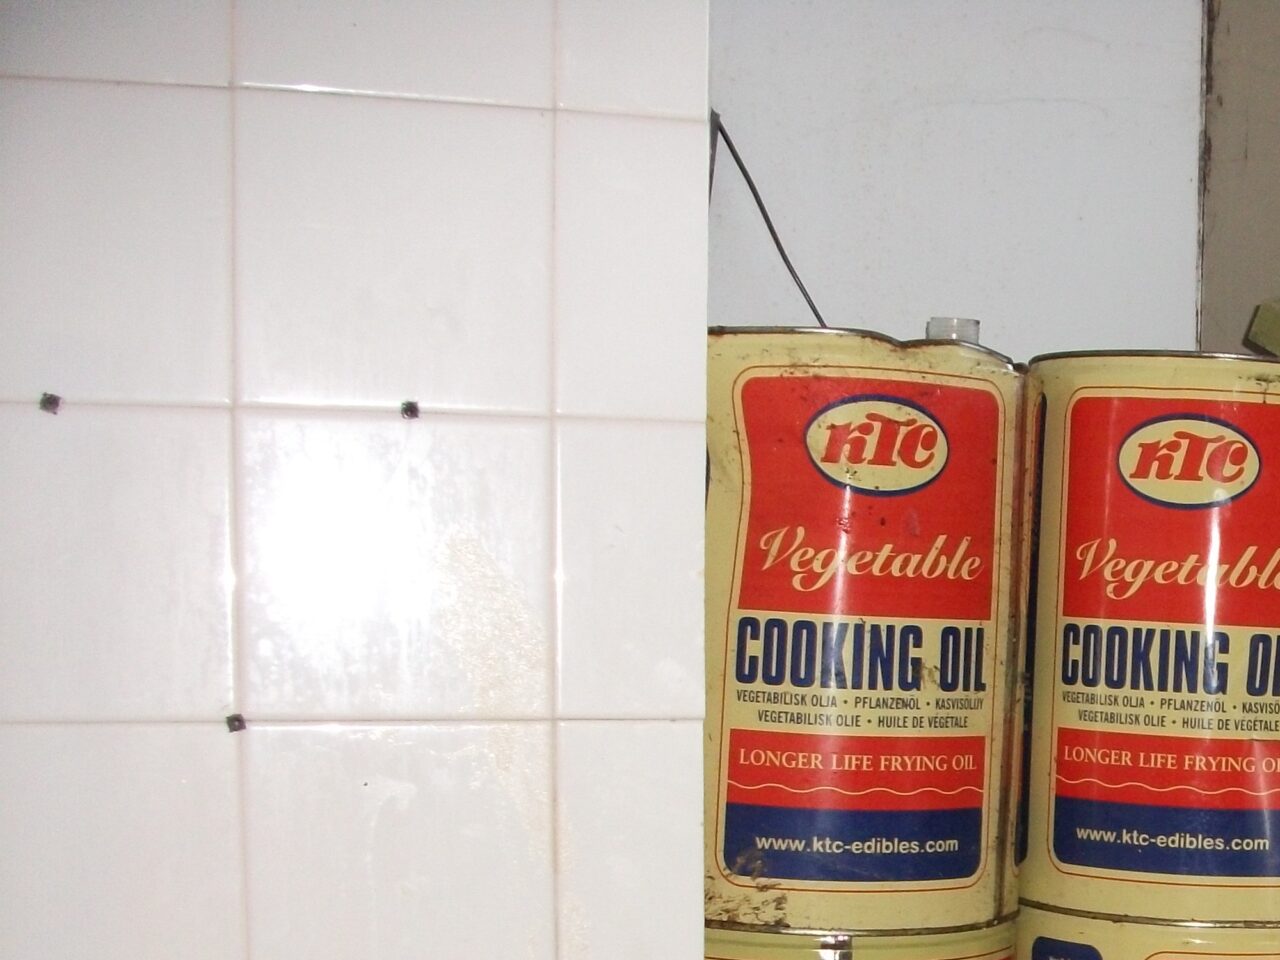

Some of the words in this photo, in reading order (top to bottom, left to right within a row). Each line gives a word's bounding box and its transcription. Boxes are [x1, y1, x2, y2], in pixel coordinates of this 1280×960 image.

[820, 412, 938, 469] KTC
[1129, 430, 1249, 483] KTC
[760, 526, 984, 592] Vegetable
[735, 616, 923, 691] COOKING
[939, 625, 987, 692] OIL
[1061, 622, 1230, 696] COOKING
[736, 689, 807, 707] VEGETABILISK
[811, 694, 837, 709] OLJA
[1062, 690, 1120, 707] VEGETABILISK
[1122, 695, 1145, 709] OLJA
[758, 709, 832, 727] VEGETABILISK
[836, 713, 861, 728] OLIE
[878, 715, 908, 729] HUILE
[912, 715, 925, 729] DE
[1078, 709, 1141, 726] VEGETABILISK
[1144, 714, 1167, 728] OLIE
[1182, 717, 1213, 730] HUILE
[1217, 719, 1231, 731] DE
[739, 747, 823, 770] LONGER
[831, 753, 873, 771] LIFE
[880, 755, 948, 772] FRYING
[951, 754, 977, 771] OIL
[1063, 745, 1133, 767] LONGER
[1139, 752, 1178, 769] LIFE
[1183, 754, 1257, 774] FRYING
[755, 835, 959, 855] www.ktc-edibles.com
[1076, 826, 1270, 851] www.ktc-edibles.com
